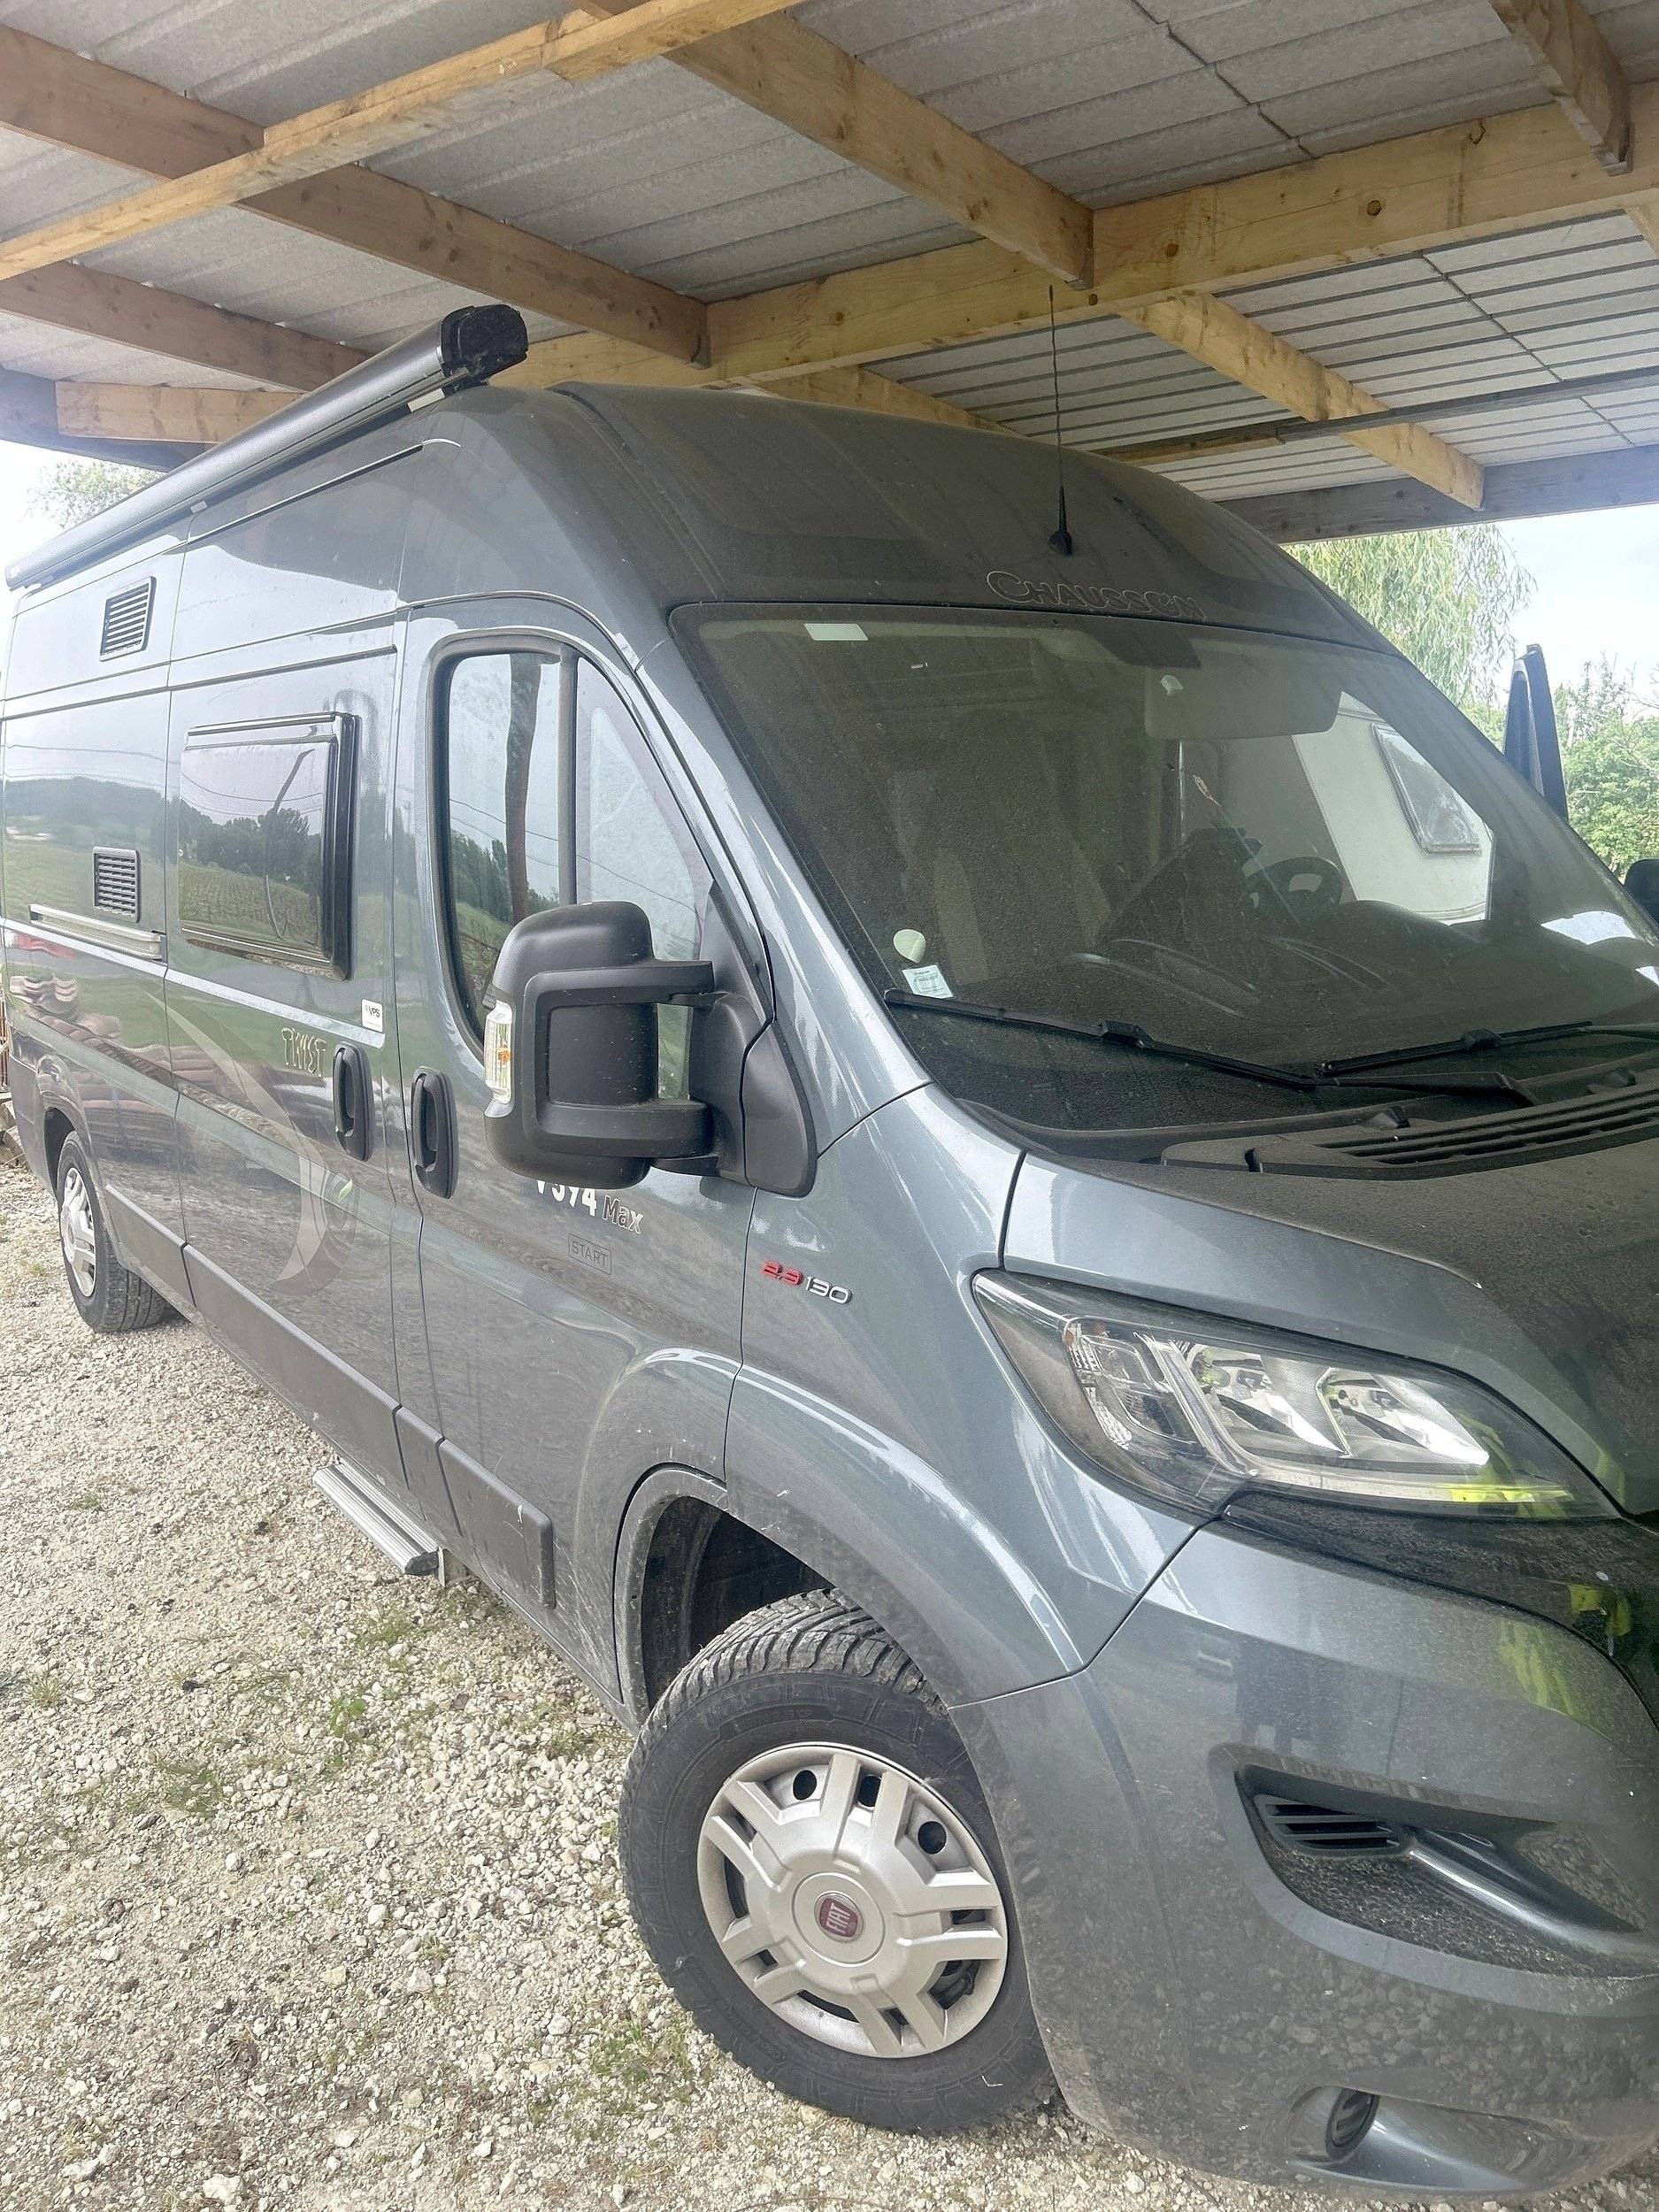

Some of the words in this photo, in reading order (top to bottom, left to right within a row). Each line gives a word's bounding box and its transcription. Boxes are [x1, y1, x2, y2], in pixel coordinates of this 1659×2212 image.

[987, 571, 1207, 619] CHAUSSON
[281, 1027, 326, 1078] TWIST
[603, 1194, 643, 1234] Max
[571, 1240, 609, 1266] START
[761, 1260, 803, 1286] 2.3
[806, 1276, 852, 1304] 130
[826, 1902, 851, 1934] FIAT
